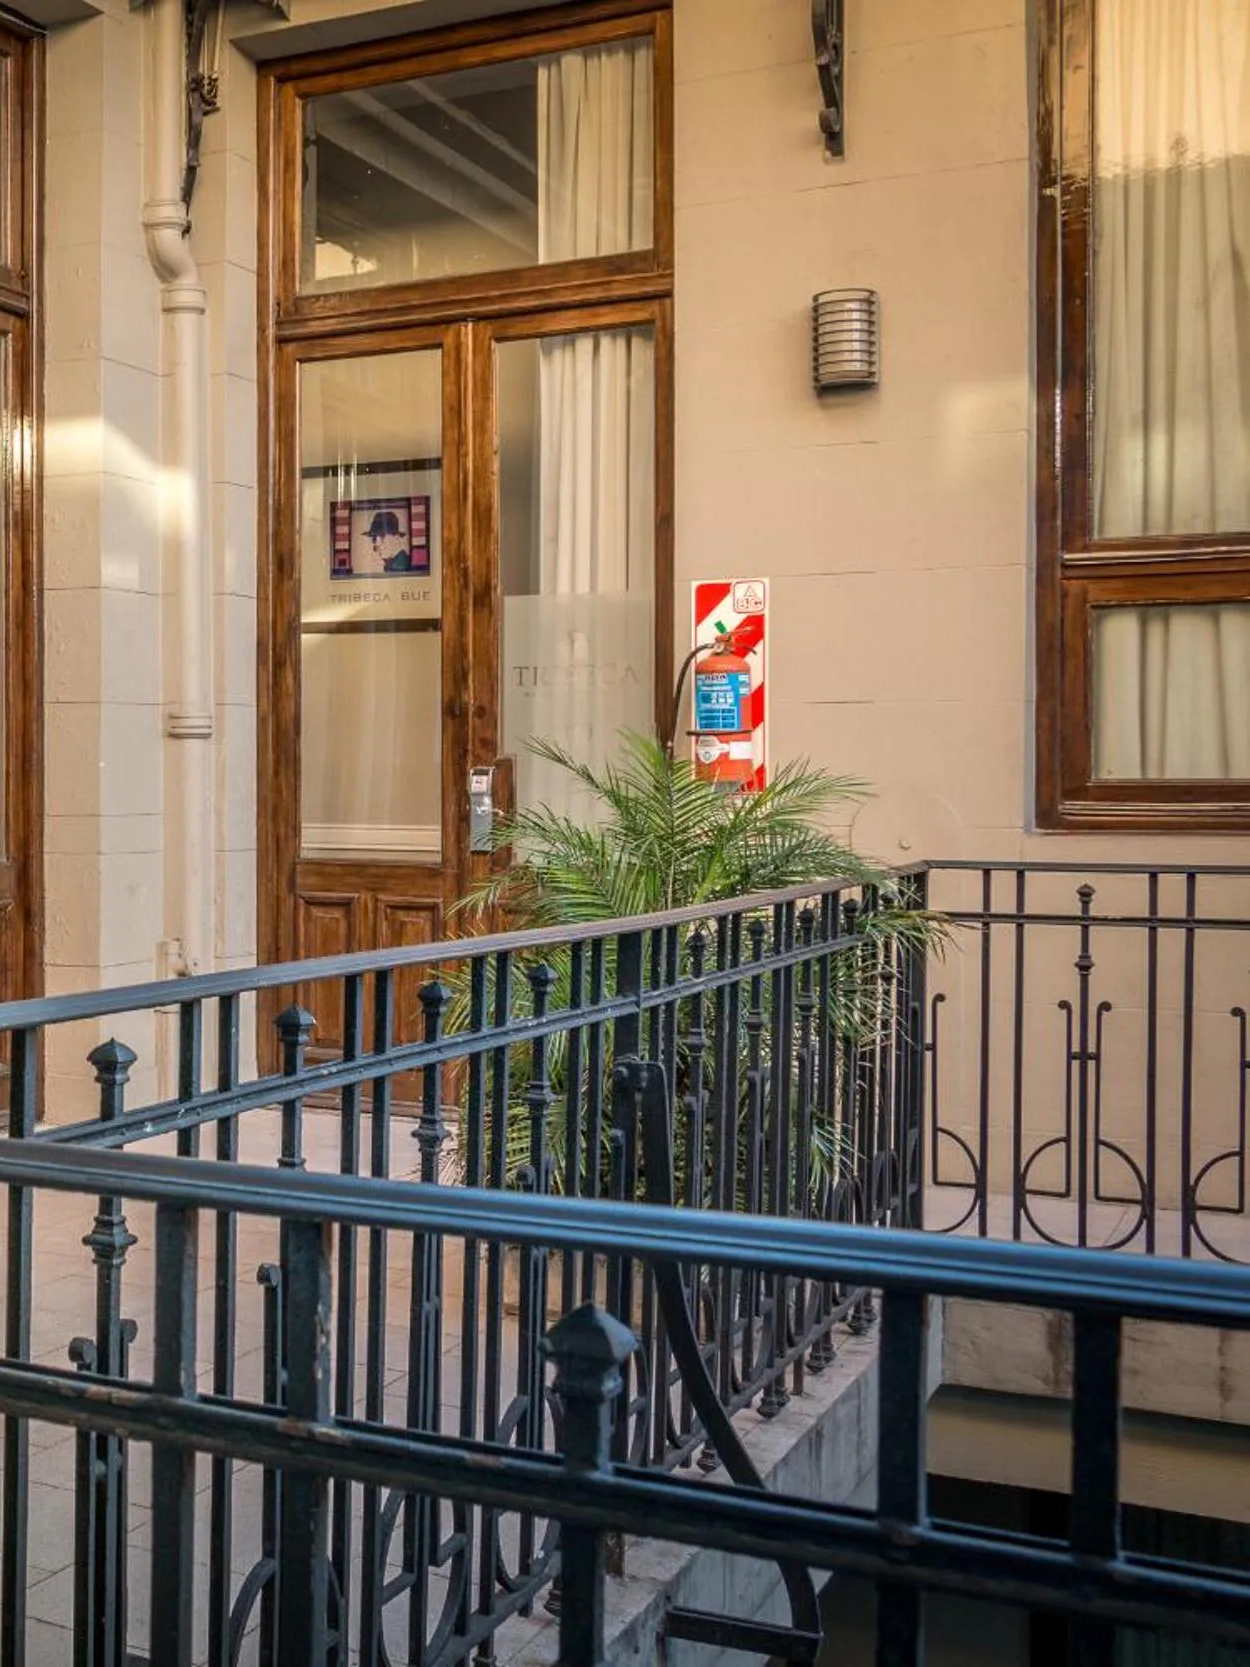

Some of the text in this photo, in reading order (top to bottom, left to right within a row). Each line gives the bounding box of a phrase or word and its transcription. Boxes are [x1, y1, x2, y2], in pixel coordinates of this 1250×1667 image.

[328, 590, 431, 604] TRIBECA BUE
[512, 662, 641, 687] TRECA
